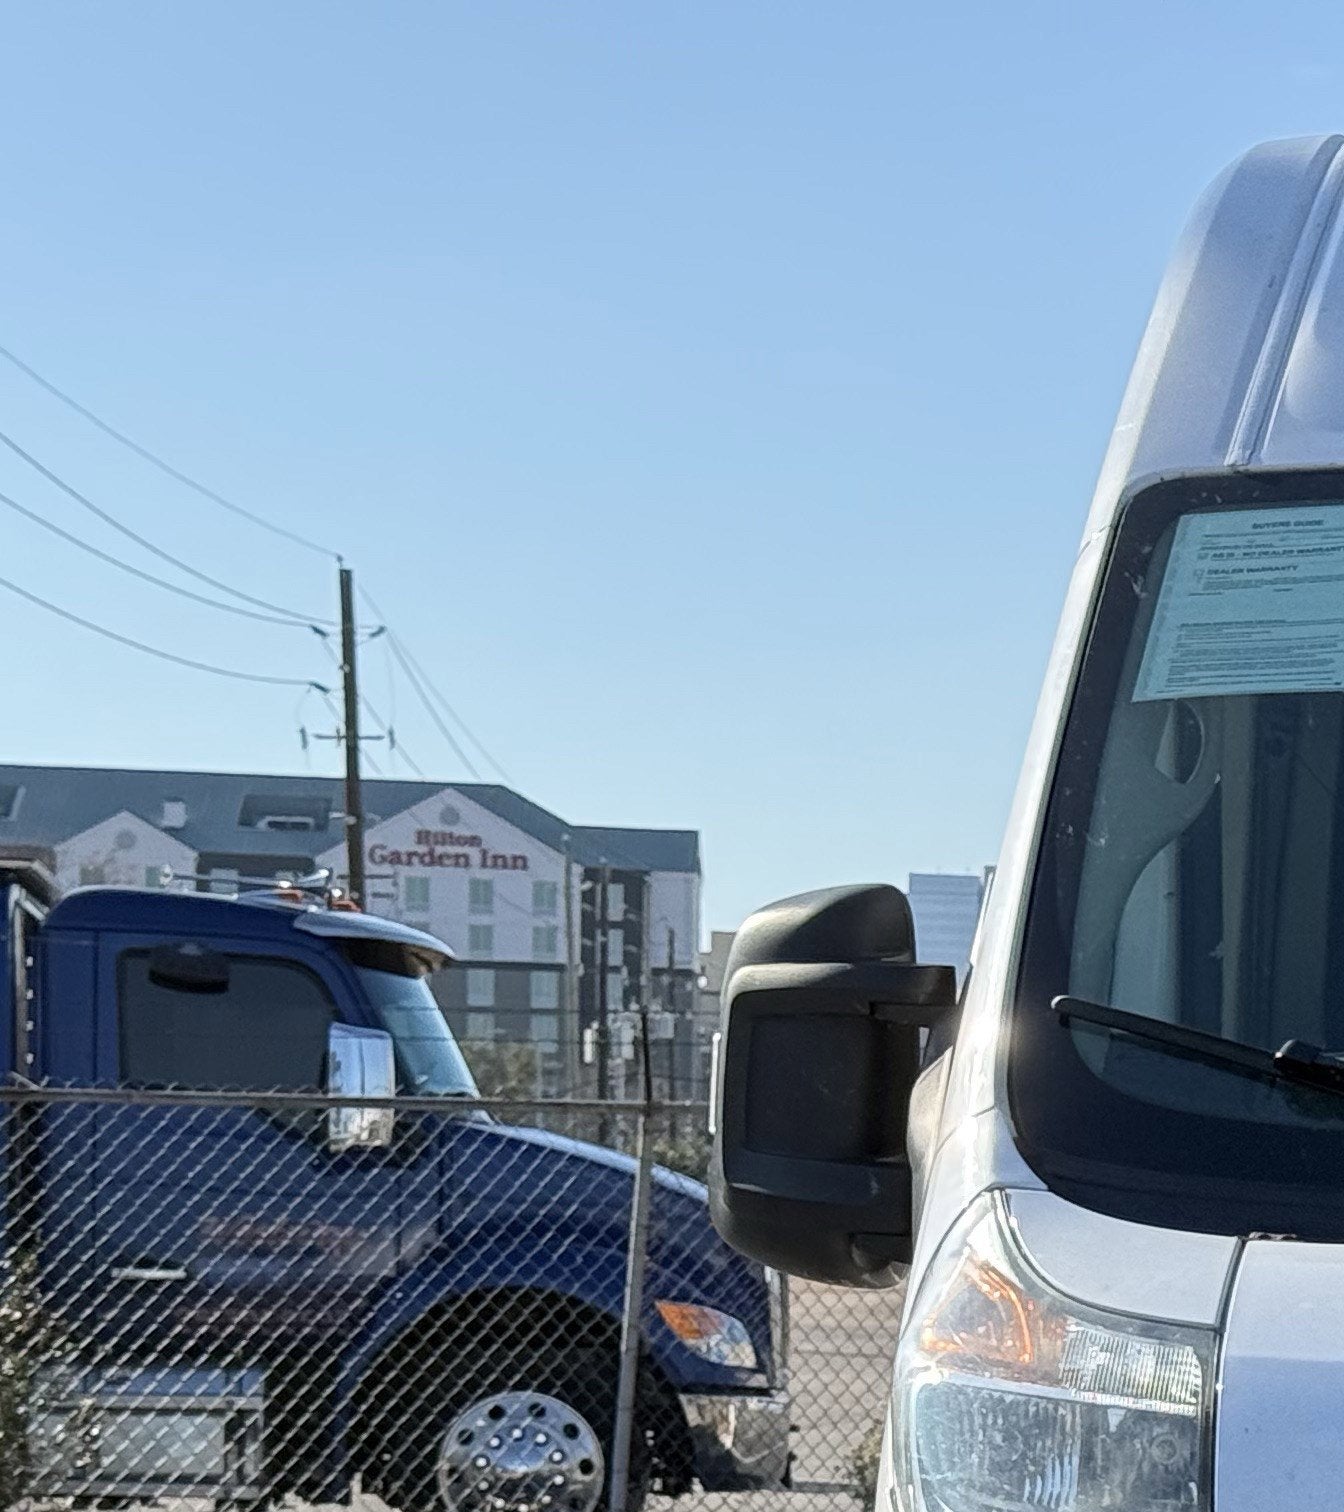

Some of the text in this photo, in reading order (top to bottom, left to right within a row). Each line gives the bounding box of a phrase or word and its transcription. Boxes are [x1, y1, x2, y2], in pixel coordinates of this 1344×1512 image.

[415, 829, 482, 847] Hilton
[368, 843, 529, 871] Garden Inn
